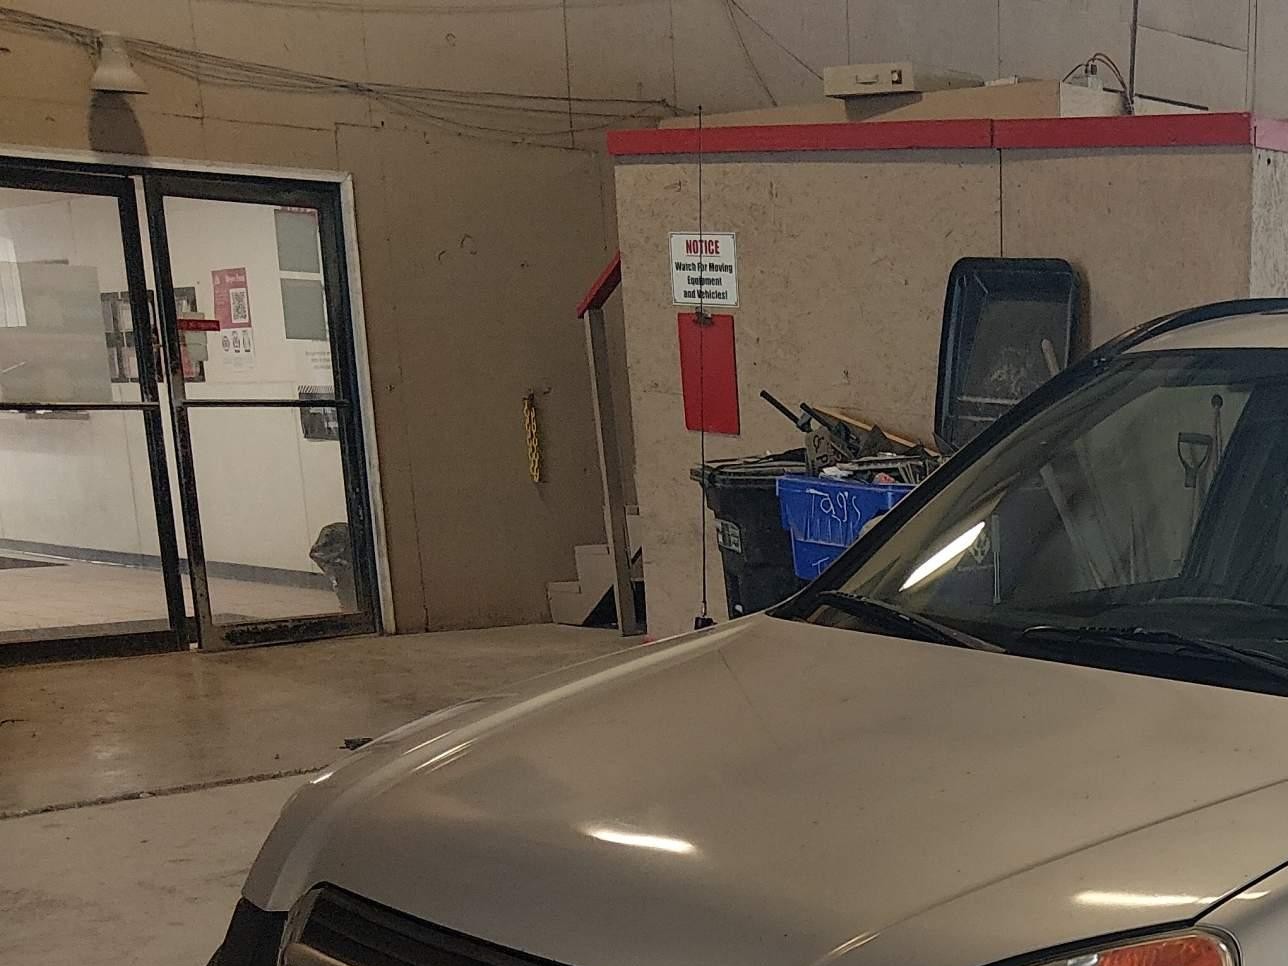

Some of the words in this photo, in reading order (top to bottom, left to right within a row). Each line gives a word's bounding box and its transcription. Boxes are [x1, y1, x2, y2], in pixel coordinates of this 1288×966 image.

[685, 240, 720, 255] NOTICE
[675, 262, 697, 272] Watch
[697, 262, 708, 272] For
[708, 262, 733, 274] Moving
[687, 275, 722, 287] Equipment
[683, 289, 696, 299] and
